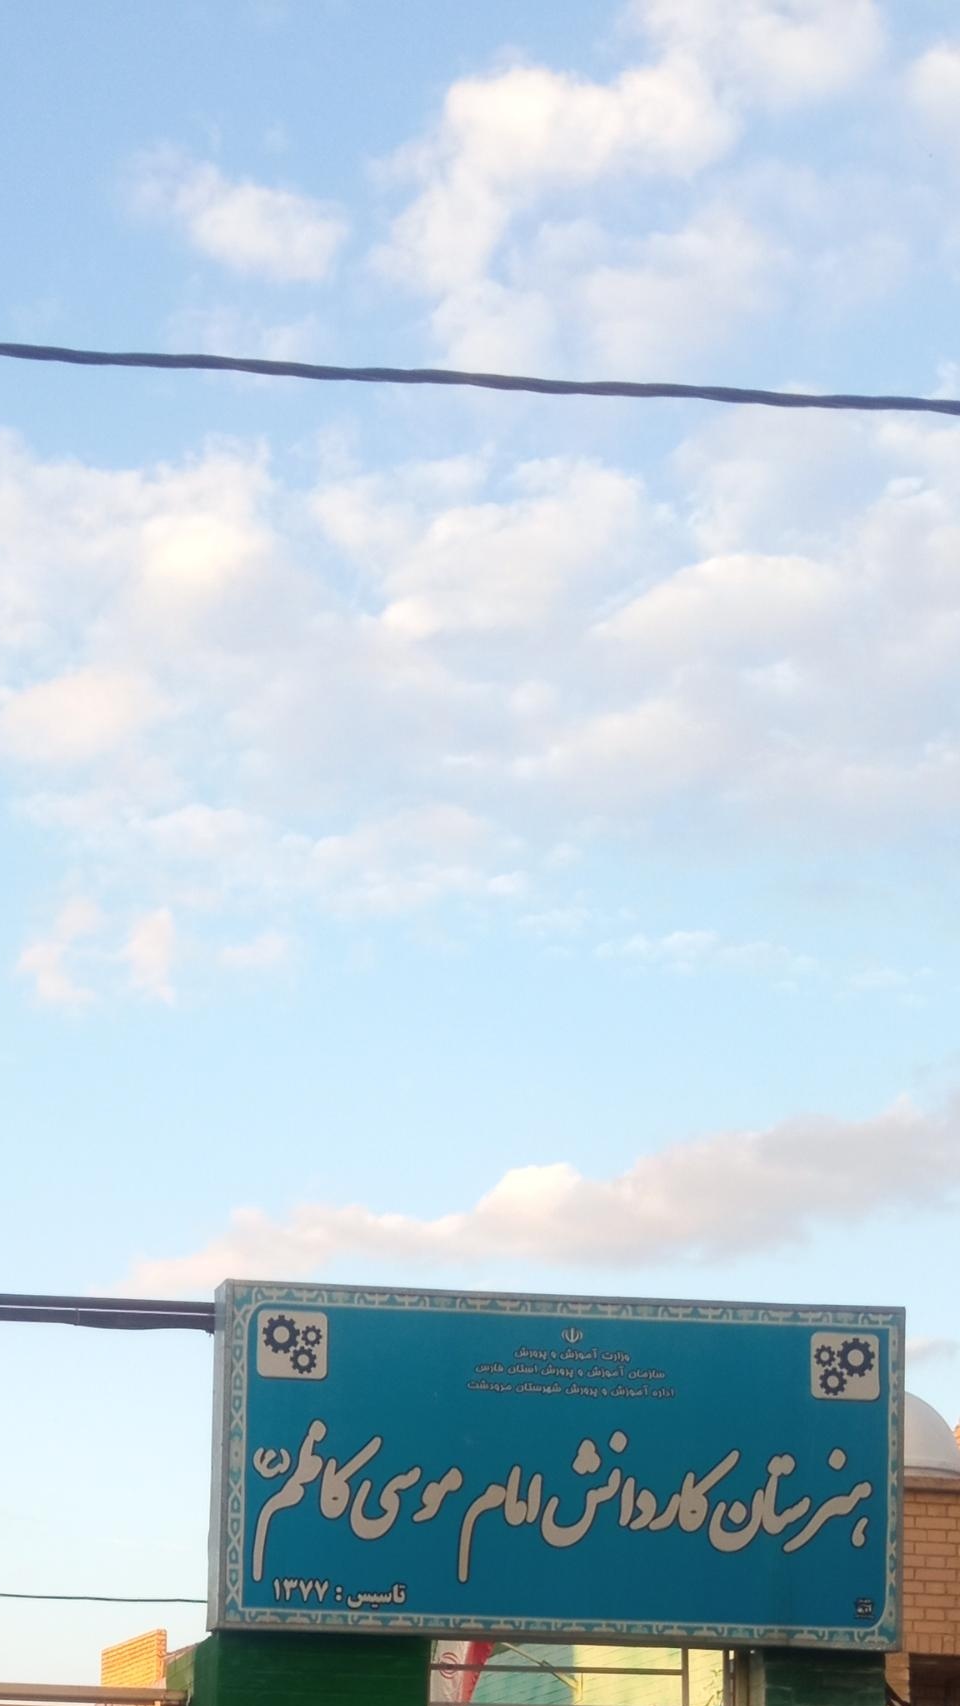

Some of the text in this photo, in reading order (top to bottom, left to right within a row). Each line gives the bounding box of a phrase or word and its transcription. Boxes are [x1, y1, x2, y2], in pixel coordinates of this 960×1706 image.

[514, 1347, 548, 1360] پرورش
[560, 1348, 598, 1361] آموزش
[601, 1351, 631, 1362] وزارت
[474, 1362, 505, 1374] فارس
[507, 1364, 538, 1375] استان
[540, 1364, 574, 1378] پرورش
[586, 1366, 625, 1378] آموزش
[627, 1369, 666, 1380] سازمان
[467, 1380, 513, 1393] مرودشت
[515, 1381, 562, 1394] شهرستان
[564, 1383, 600, 1398] پرورش
[610, 1385, 649, 1398] آموزش
[651, 1388, 675, 1399] اداره
[251, 1418, 383, 1583] کاظم
[349, 1465, 464, 1541] موسی
[708, 1447, 874, 1554] هنرستان
[457, 1463, 543, 1584] امام
[273, 1577, 329, 1602] ۱۳۷۷
